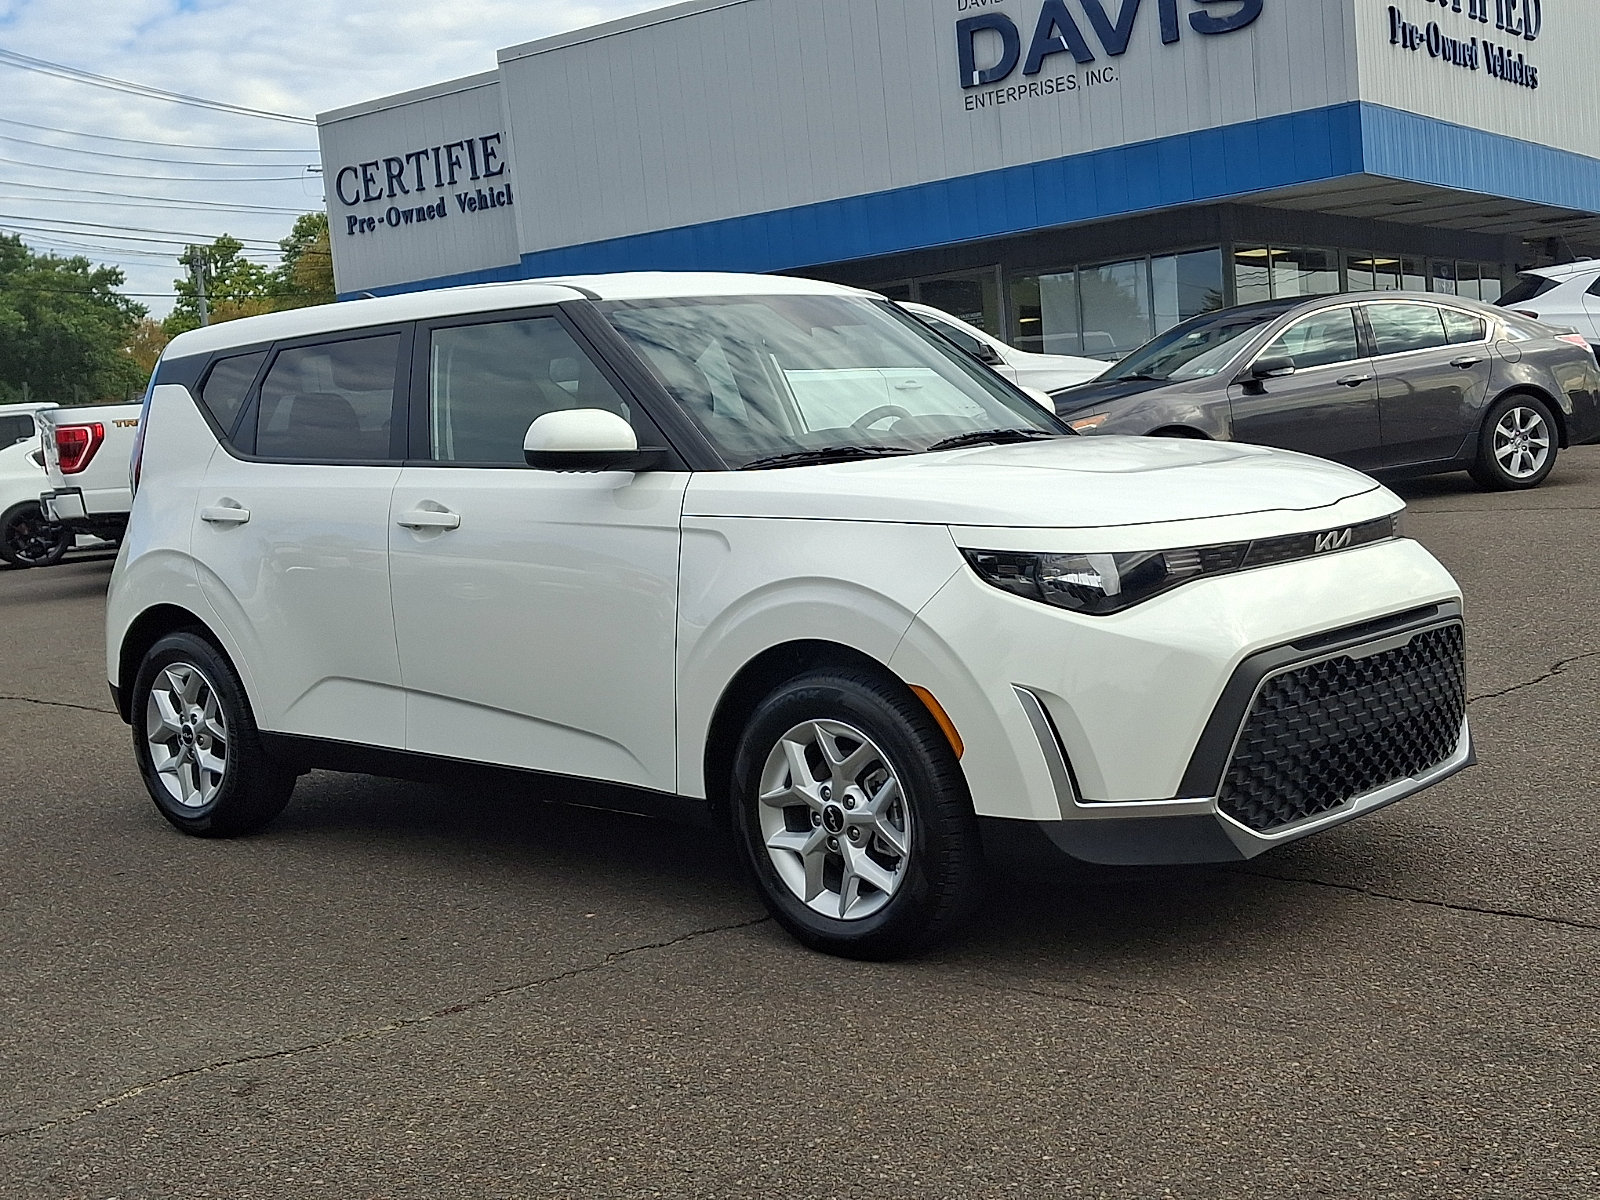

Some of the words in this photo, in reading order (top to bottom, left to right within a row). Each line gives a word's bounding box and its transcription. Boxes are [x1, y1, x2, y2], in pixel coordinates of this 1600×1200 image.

[1388, 5, 1479, 71] Pre-Owned
[1482, 40, 1538, 90] Vehicles
[964, 75, 1081, 111] ENTERPRISES,
[1085, 66, 1119, 87] INC.
[335, 131, 511, 206] CERTIFIE
[346, 196, 447, 235] Pre-Owned
[455, 183, 513, 213] Vehicl
